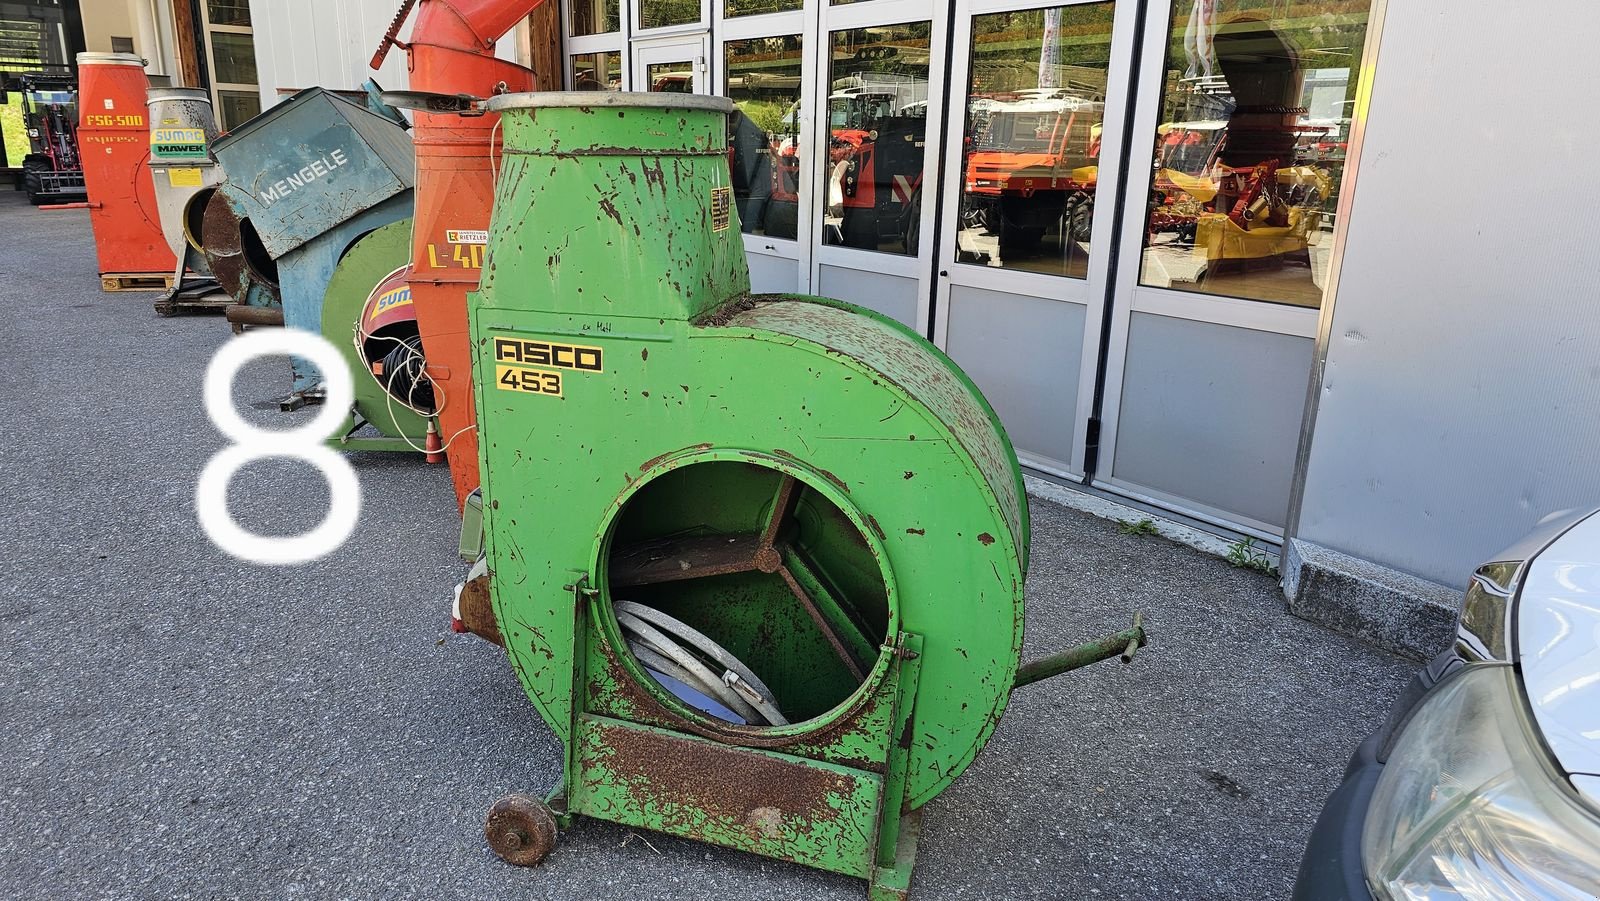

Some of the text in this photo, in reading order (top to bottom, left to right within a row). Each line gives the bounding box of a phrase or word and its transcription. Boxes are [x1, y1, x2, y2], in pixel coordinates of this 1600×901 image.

[86, 115, 143, 126] FSG-500
[260, 148, 348, 205] MENGELE
[496, 340, 602, 371] ASCO
[500, 369, 561, 395] 453
